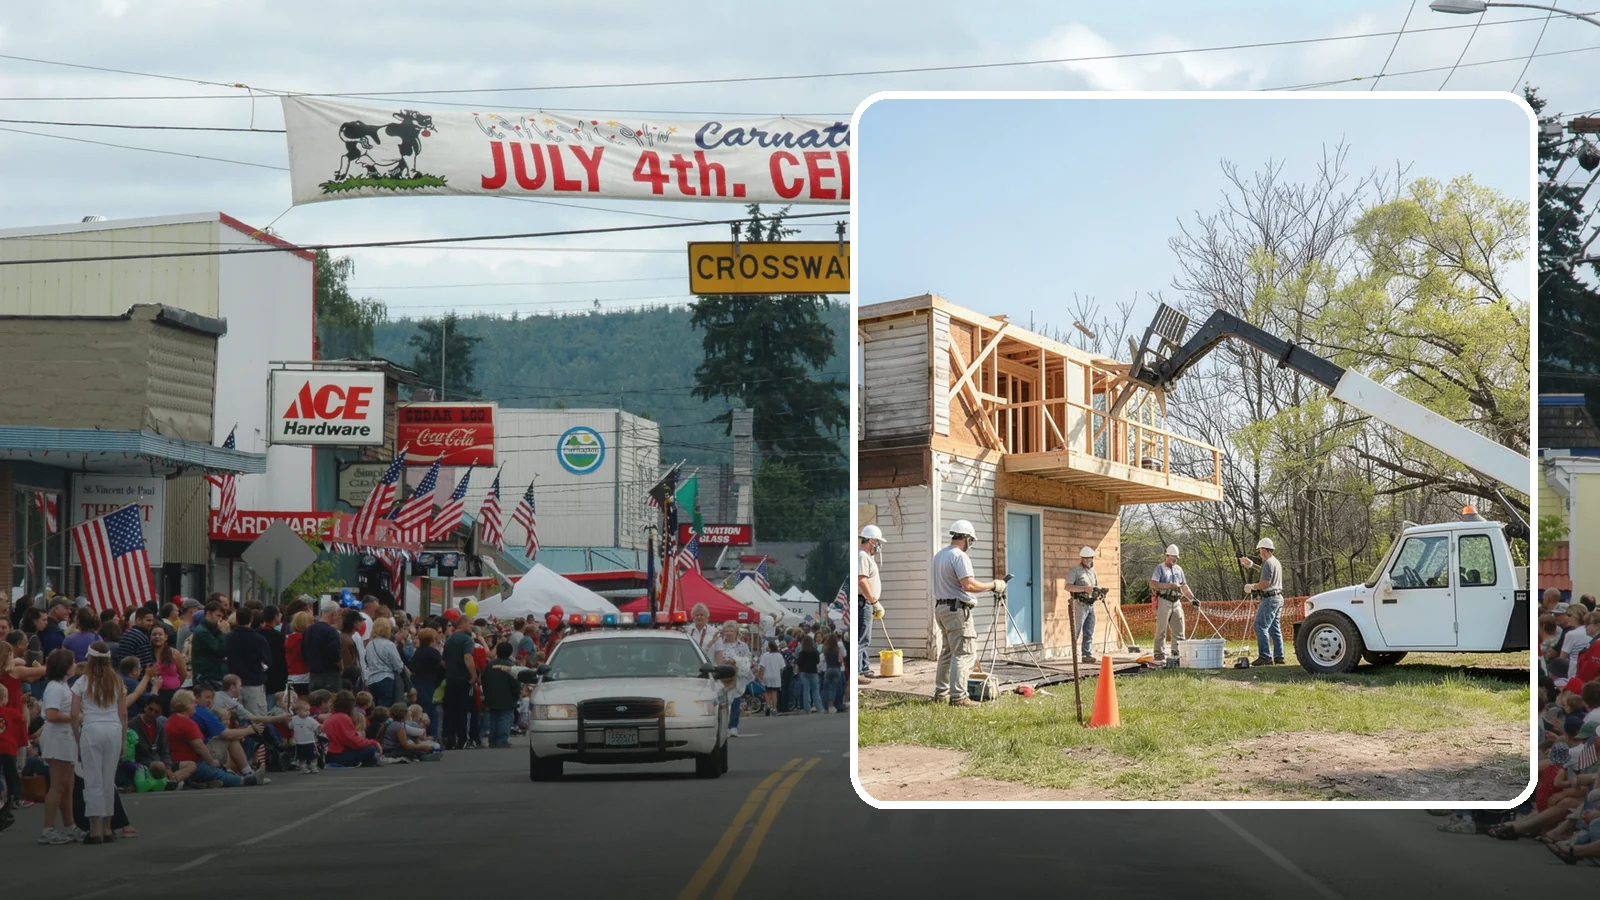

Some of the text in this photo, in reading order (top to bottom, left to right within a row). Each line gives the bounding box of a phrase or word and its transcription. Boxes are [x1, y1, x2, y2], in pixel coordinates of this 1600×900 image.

[695, 121, 850, 150] Carnat
[481, 140, 605, 192] JULY
[632, 149, 747, 198] 4th.
[697, 254, 850, 280] CROSSWA
[282, 380, 373, 420] ACE
[406, 409, 452, 422] CEDAR
[283, 421, 371, 436] Hardware
[416, 428, 477, 446] Coca-Cola
[353, 467, 385, 480] Simpl
[83, 484, 155, 496] St. Vincent de Paul
[688, 526, 741, 535] CRNATION
[699, 535, 730, 543] GLASS
